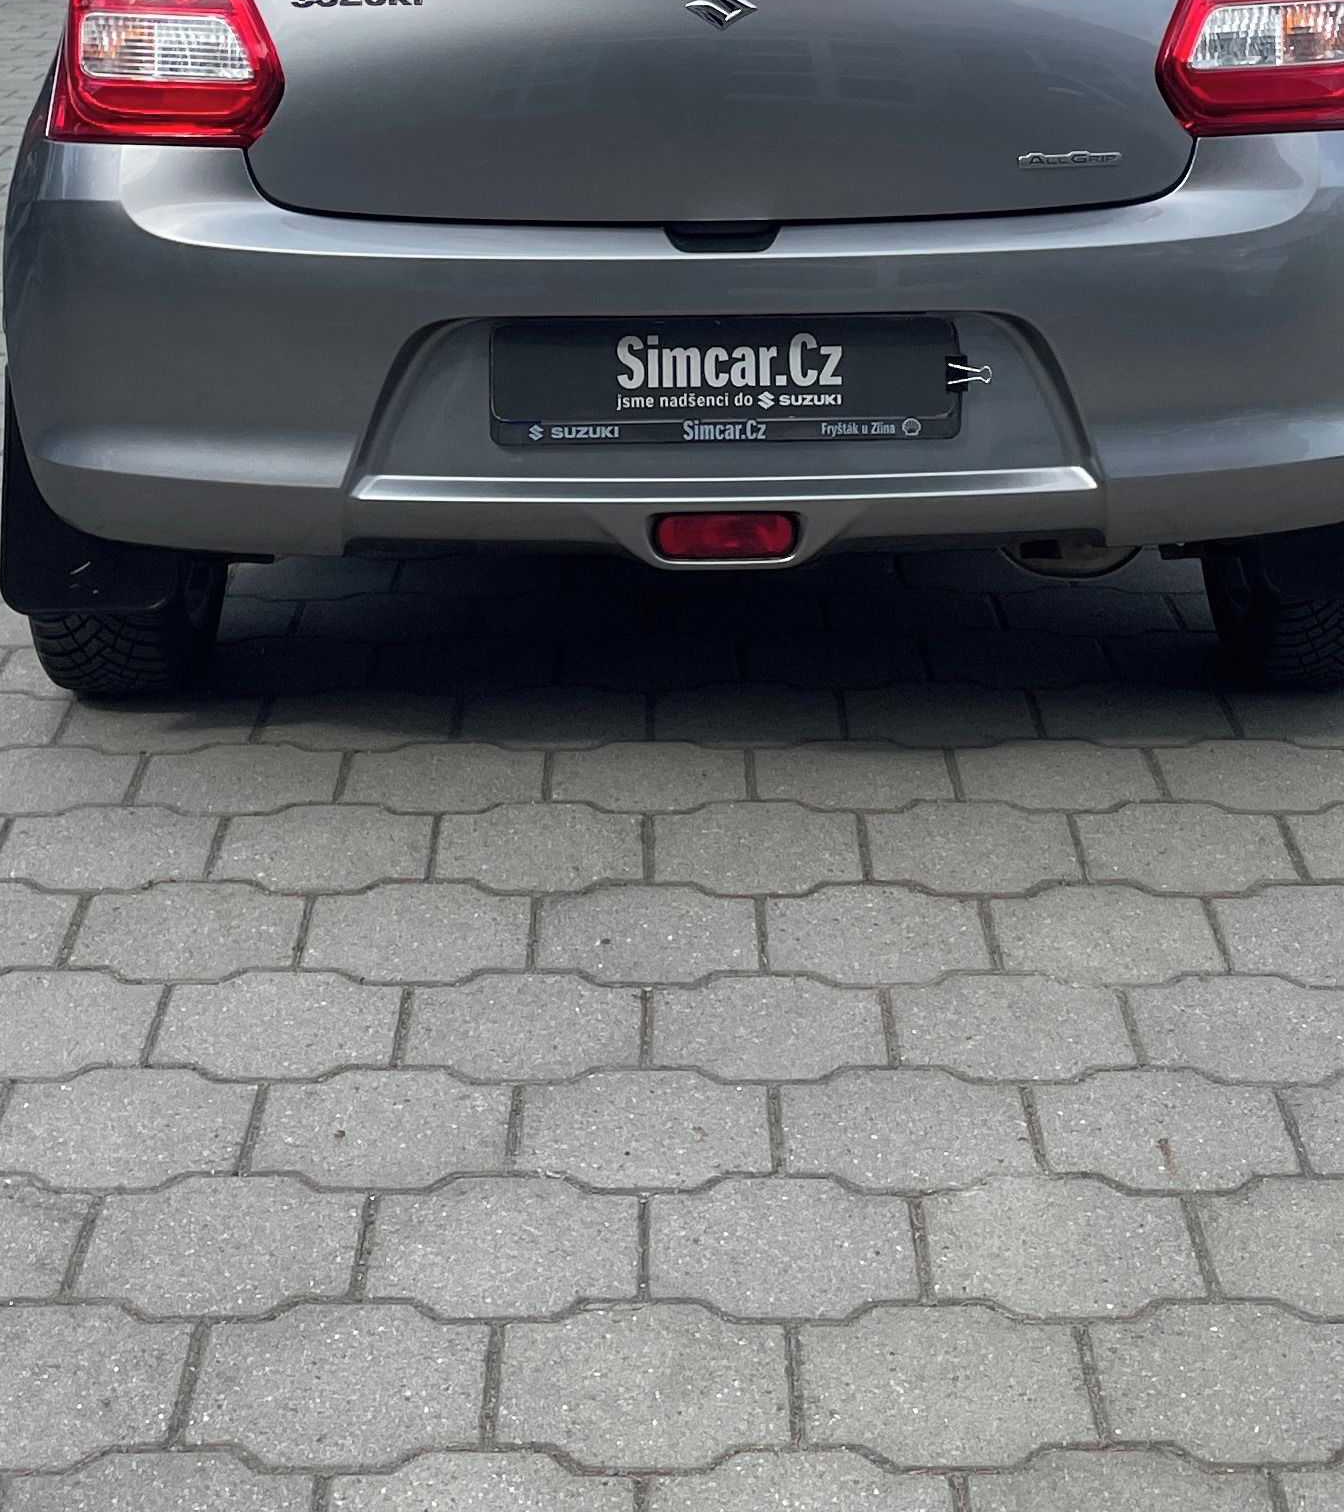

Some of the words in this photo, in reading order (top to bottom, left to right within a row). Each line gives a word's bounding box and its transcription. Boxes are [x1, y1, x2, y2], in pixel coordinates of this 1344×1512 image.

[616, 332, 843, 389] Simcar.Cz
[616, 394, 654, 410] jsme
[659, 392, 729, 408] nadšenci
[734, 392, 753, 406] do
[779, 394, 842, 405] SUZUKI
[551, 426, 619, 438] SUZUKI
[683, 420, 766, 440] Simcar.Cz
[821, 422, 858, 437] Fryšták
[862, 425, 868, 434] u
